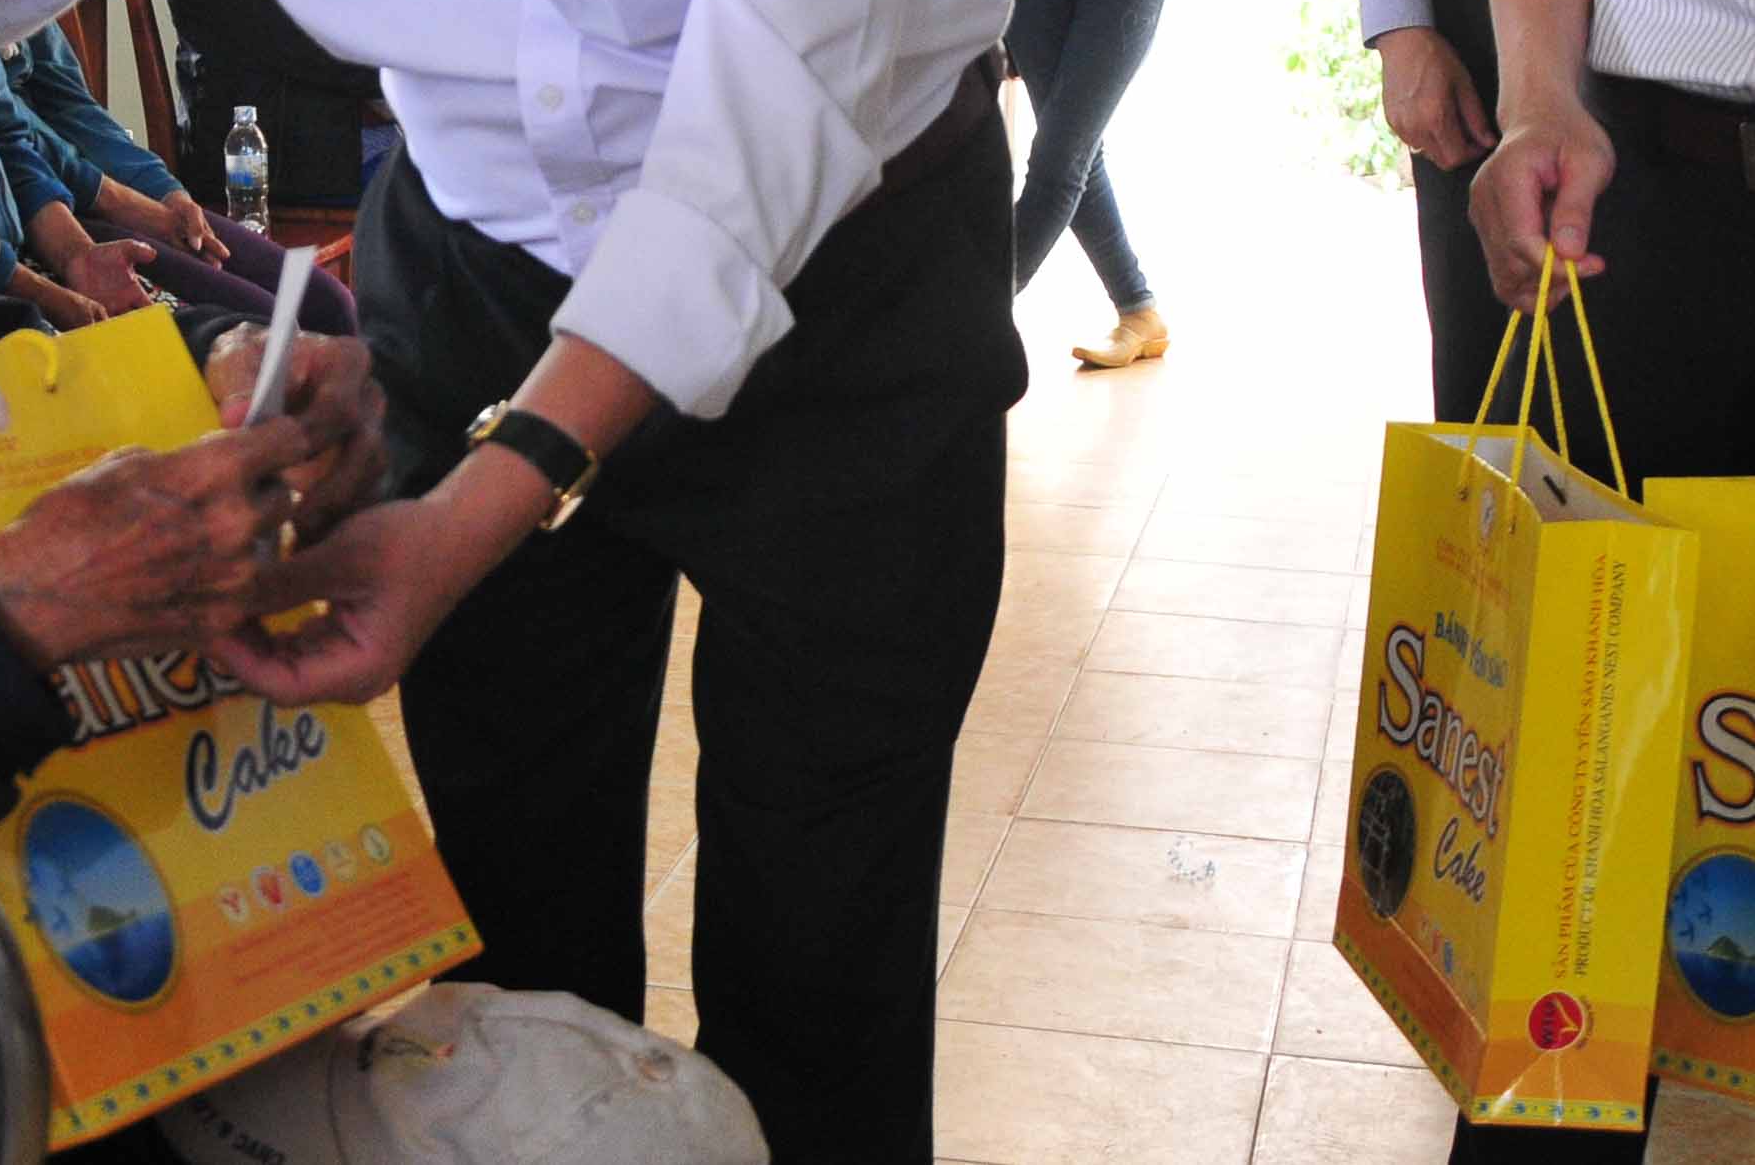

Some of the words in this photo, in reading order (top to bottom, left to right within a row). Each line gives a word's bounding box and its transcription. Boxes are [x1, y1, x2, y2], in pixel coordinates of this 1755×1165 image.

[1606, 561, 1627, 636] COMPANY
[1602, 642, 1620, 678] NEST
[185, 701, 326, 832] Cake
[1379, 624, 1503, 837] Sanest
[1433, 817, 1486, 904] Cake
[1573, 906, 1593, 976] PRODUCT
